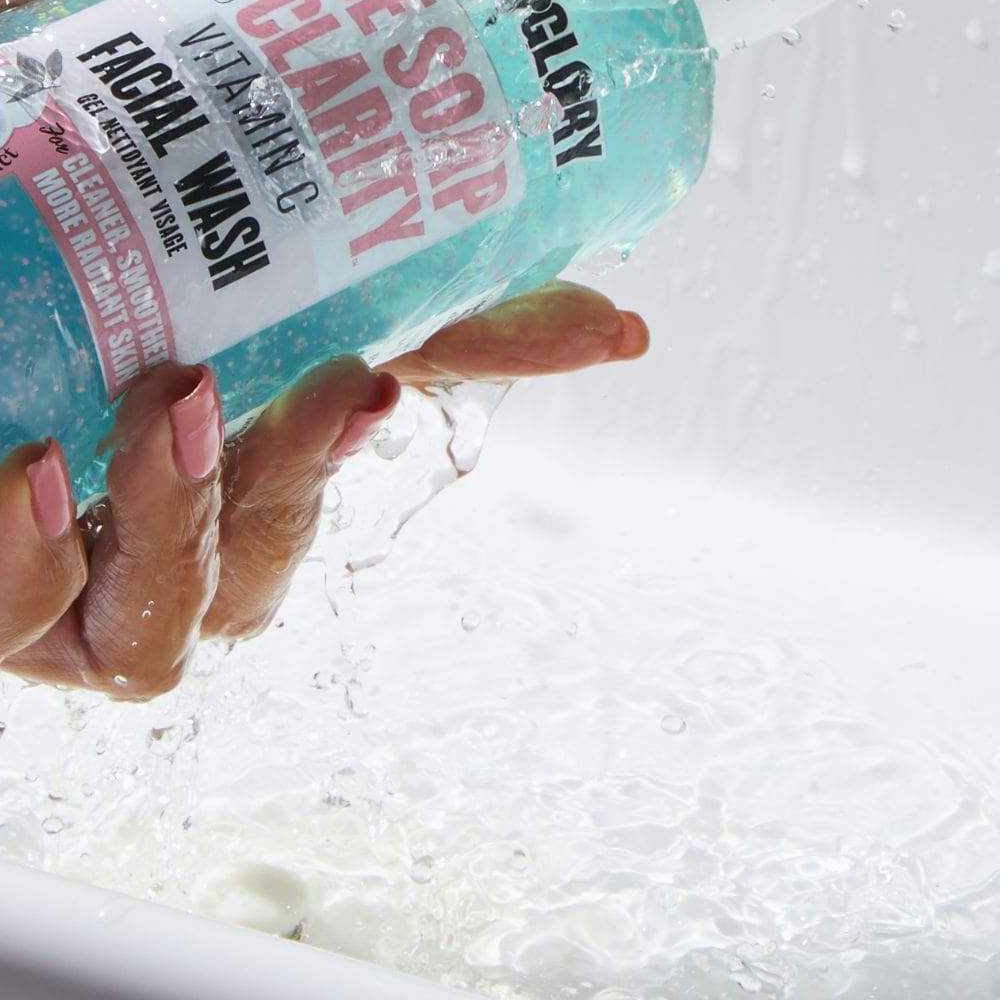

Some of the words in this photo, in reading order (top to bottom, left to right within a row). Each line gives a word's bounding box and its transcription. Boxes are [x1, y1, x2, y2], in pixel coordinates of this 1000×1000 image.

[76, 31, 211, 159] FACIAL
[174, 150, 271, 292] WASH
[77, 92, 102, 121] GEL
[100, 116, 162, 199] NETTOYANT
[149, 198, 188, 258] VISAGE
[180, 22, 306, 176] VITAMIN
[277, 180, 320, 215] C
[384, 27, 508, 217] SOAP
[521, 2, 602, 168] GLORY
[32, 167, 89, 234] MORE
[69, 228, 130, 329] RADIANT
[108, 328, 142, 387] SKIN
[39, 121, 71, 155] For
[62, 152, 131, 254] CLEANER,
